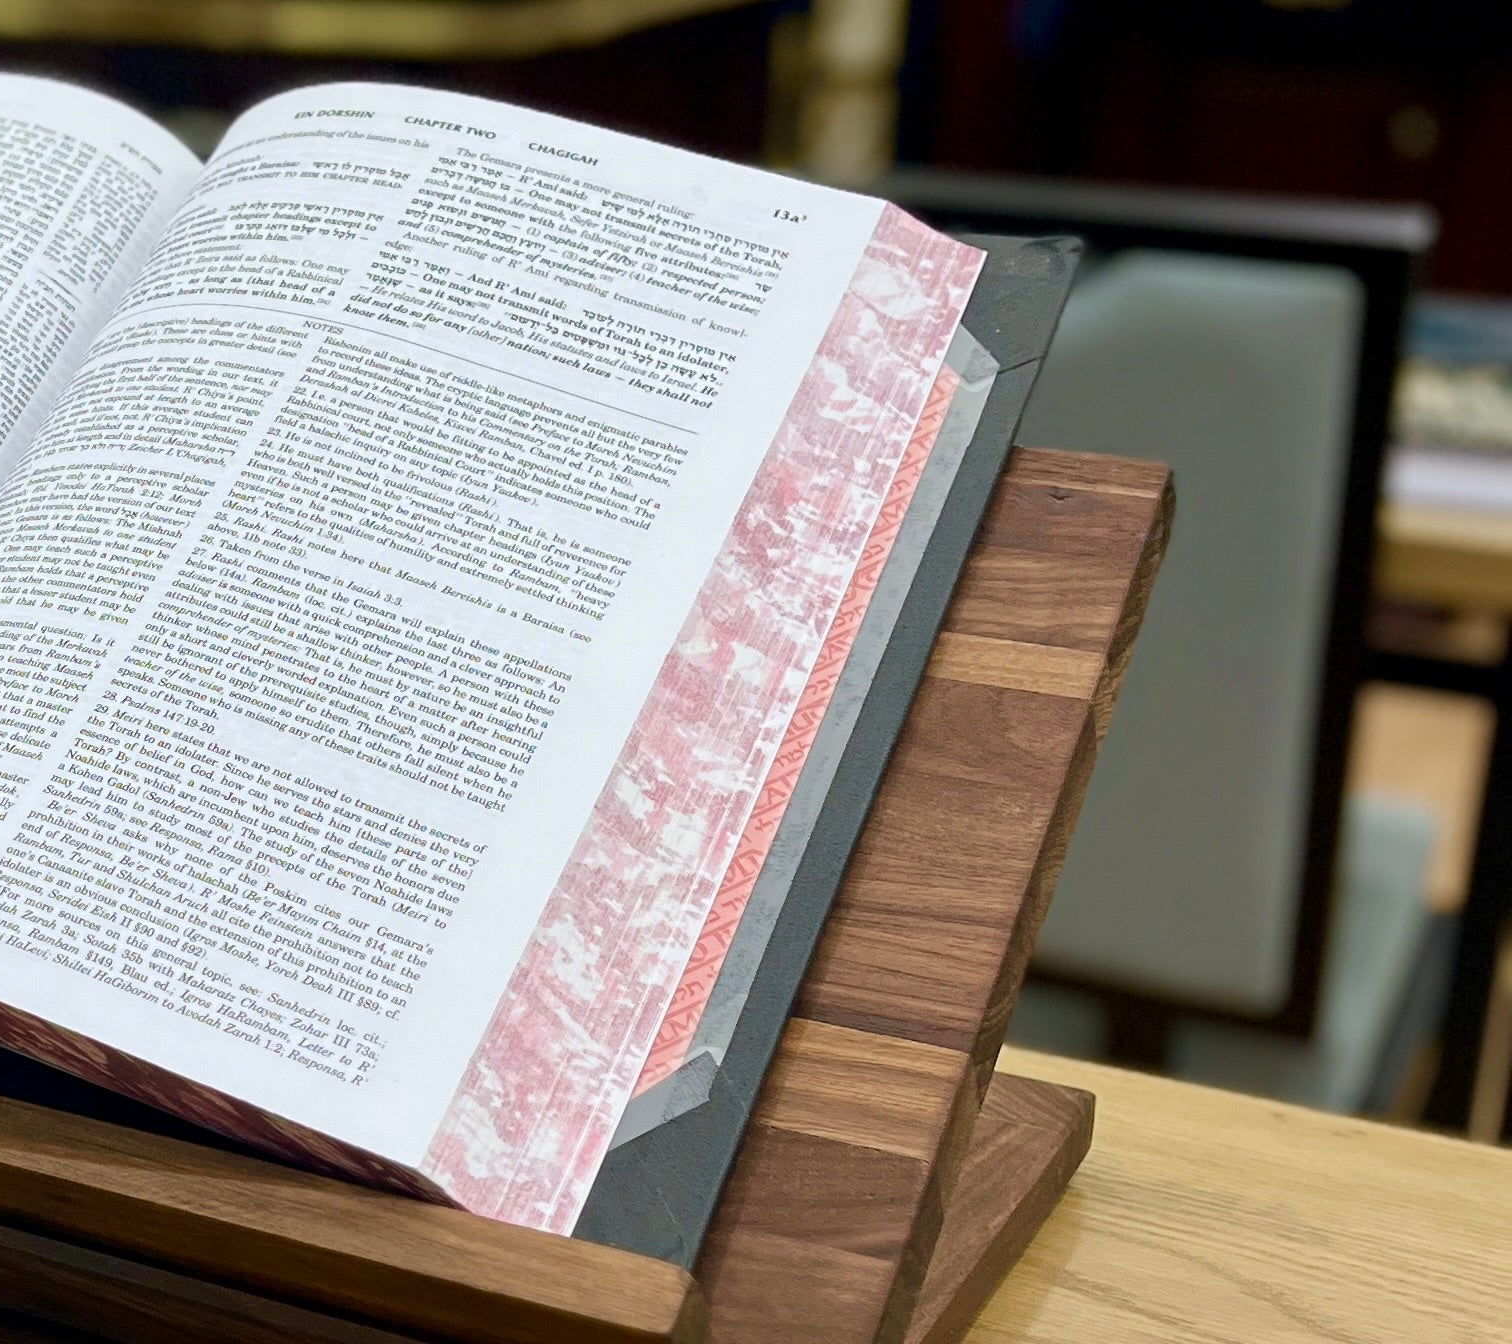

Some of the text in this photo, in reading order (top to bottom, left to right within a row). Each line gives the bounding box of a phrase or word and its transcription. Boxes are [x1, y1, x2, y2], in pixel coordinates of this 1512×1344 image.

[294, 110, 315, 120] EIN
[316, 109, 375, 119] DORSHIN
[404, 115, 464, 133] CHAPTER
[465, 126, 497, 140] TWO
[528, 142, 599, 166] CHAGIGAH
[456, 147, 477, 158] The
[479, 153, 522, 170] Gemara
[523, 166, 571, 183] presents
[582, 182, 611, 195] more
[612, 192, 655, 208] general
[528, 189, 552, 202] One
[554, 198, 580, 211] may
[581, 207, 602, 218] not
[605, 213, 656, 233] transmit
[658, 230, 701, 246] secrets
[719, 246, 739, 258] the
[402, 231, 449, 248] Another
[452, 245, 488, 260] ruling
[524, 265, 551, 278] Ami
[554, 275, 609, 297] regarding
[613, 292, 685, 321] transmission
[422, 273, 446, 286] One
[448, 282, 474, 294] may
[474, 290, 495, 300] not
[498, 296, 549, 317] transmit
[552, 313, 588, 330] words
[606, 329, 641, 347] Torah
[467, 273, 493, 286] And
[510, 287, 536, 300] Ami
[302, 320, 345, 335] NOTES
[350, 293, 372, 304] did
[371, 300, 393, 309] not
[422, 313, 443, 323] for
[443, 320, 467, 332] any
[552, 355, 580, 368] such
[582, 362, 611, 378] laws
[628, 378, 655, 393] they
[656, 387, 690, 402] shall
[690, 398, 712, 408] not
[219, 539, 251, 556] Taken
[253, 549, 281, 564] from
[282, 559, 300, 571] the
[303, 567, 331, 581] verse
[331, 578, 344, 586] in
[345, 580, 380, 599] Isaiah
[270, 528, 305, 544] Rashi
[306, 541, 336, 555] notes
[339, 549, 364, 565] here
[368, 561, 392, 574] that
[394, 569, 436, 590] Maaseh
[440, 585, 492, 608] Bereishis
[496, 604, 506, 613] is
[521, 612, 564, 633] Baraisa
[569, 629, 591, 643] (see
[91, 634, 103, 644] Is
[106, 637, 115, 647] it
[120, 695, 161, 714] Psalms
[111, 709, 145, 725] Meiri
[144, 719, 170, 735] here
[171, 731, 205, 747] states
[207, 742, 231, 757] that
[234, 753, 249, 764] we
[250, 761, 270, 772] are
[271, 769, 292, 781] not
[294, 777, 338, 798] allowed
[339, 793, 352, 803] to
[354, 799, 404, 824] transmit
[407, 819, 427, 832] the
[428, 829, 470, 848] secrets
[472, 844, 488, 854] of
[81, 811, 116, 830] Sheva
[120, 828, 148, 842] asks
[155, 840, 179, 855] why
[184, 853, 213, 869] none
[216, 866, 235, 876] of
[238, 872, 257, 888] the
[262, 881, 307, 906] Poskim
[314, 904, 341, 919] cites
[348, 917, 370, 930] our
[23, 897, 54, 913] more
[57, 910, 101, 932] sources
[105, 929, 120, 940] on
[125, 935, 149, 952] this
[151, 948, 198, 971] general
[267, 993, 330, 1025] Sanhedrin
[52, 953, 94, 975] Shiltei
[93, 969, 159, 1003] HaGiborim
[161, 998, 174, 1009] to
[175, 1005, 222, 1029] Avodah
[223, 1022, 261, 1045] Zarah
